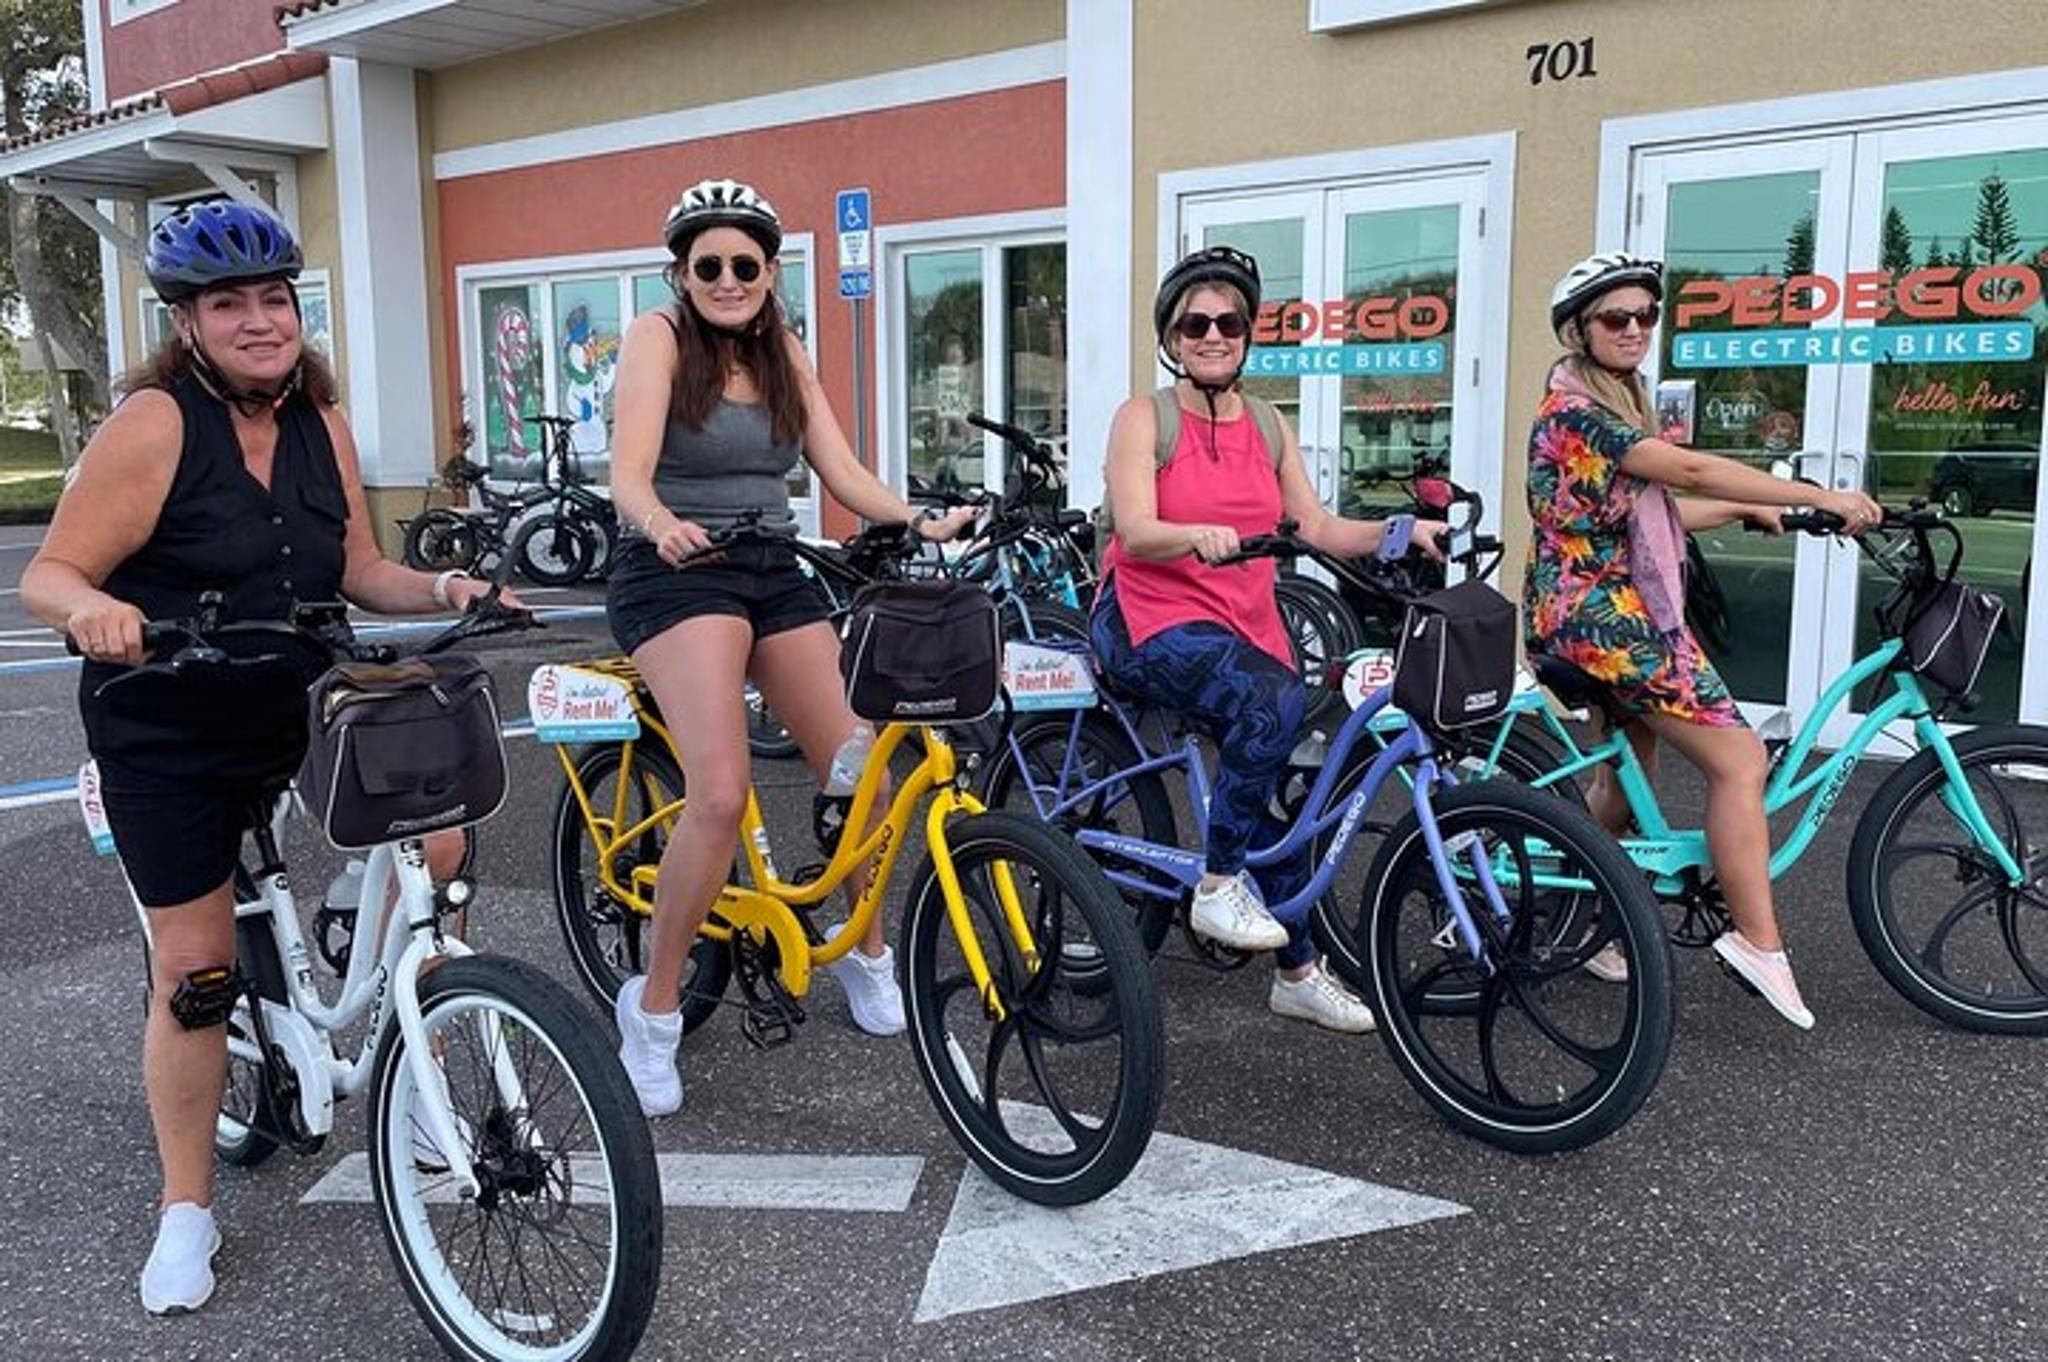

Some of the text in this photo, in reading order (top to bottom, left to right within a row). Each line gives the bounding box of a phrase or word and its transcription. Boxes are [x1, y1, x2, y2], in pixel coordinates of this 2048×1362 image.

[1526, 36, 1597, 86] 701
[1675, 264, 2041, 328] PEDEGO
[1252, 295, 1449, 343] EDEGO
[1248, 349, 1438, 371] ECTRIC BIKES
[1680, 330, 2023, 361] ELECTRIC BIKES
[1015, 672, 1047, 692] Rent
[563, 700, 593, 720] Rent
[1325, 791, 1366, 865] PEDEGO
